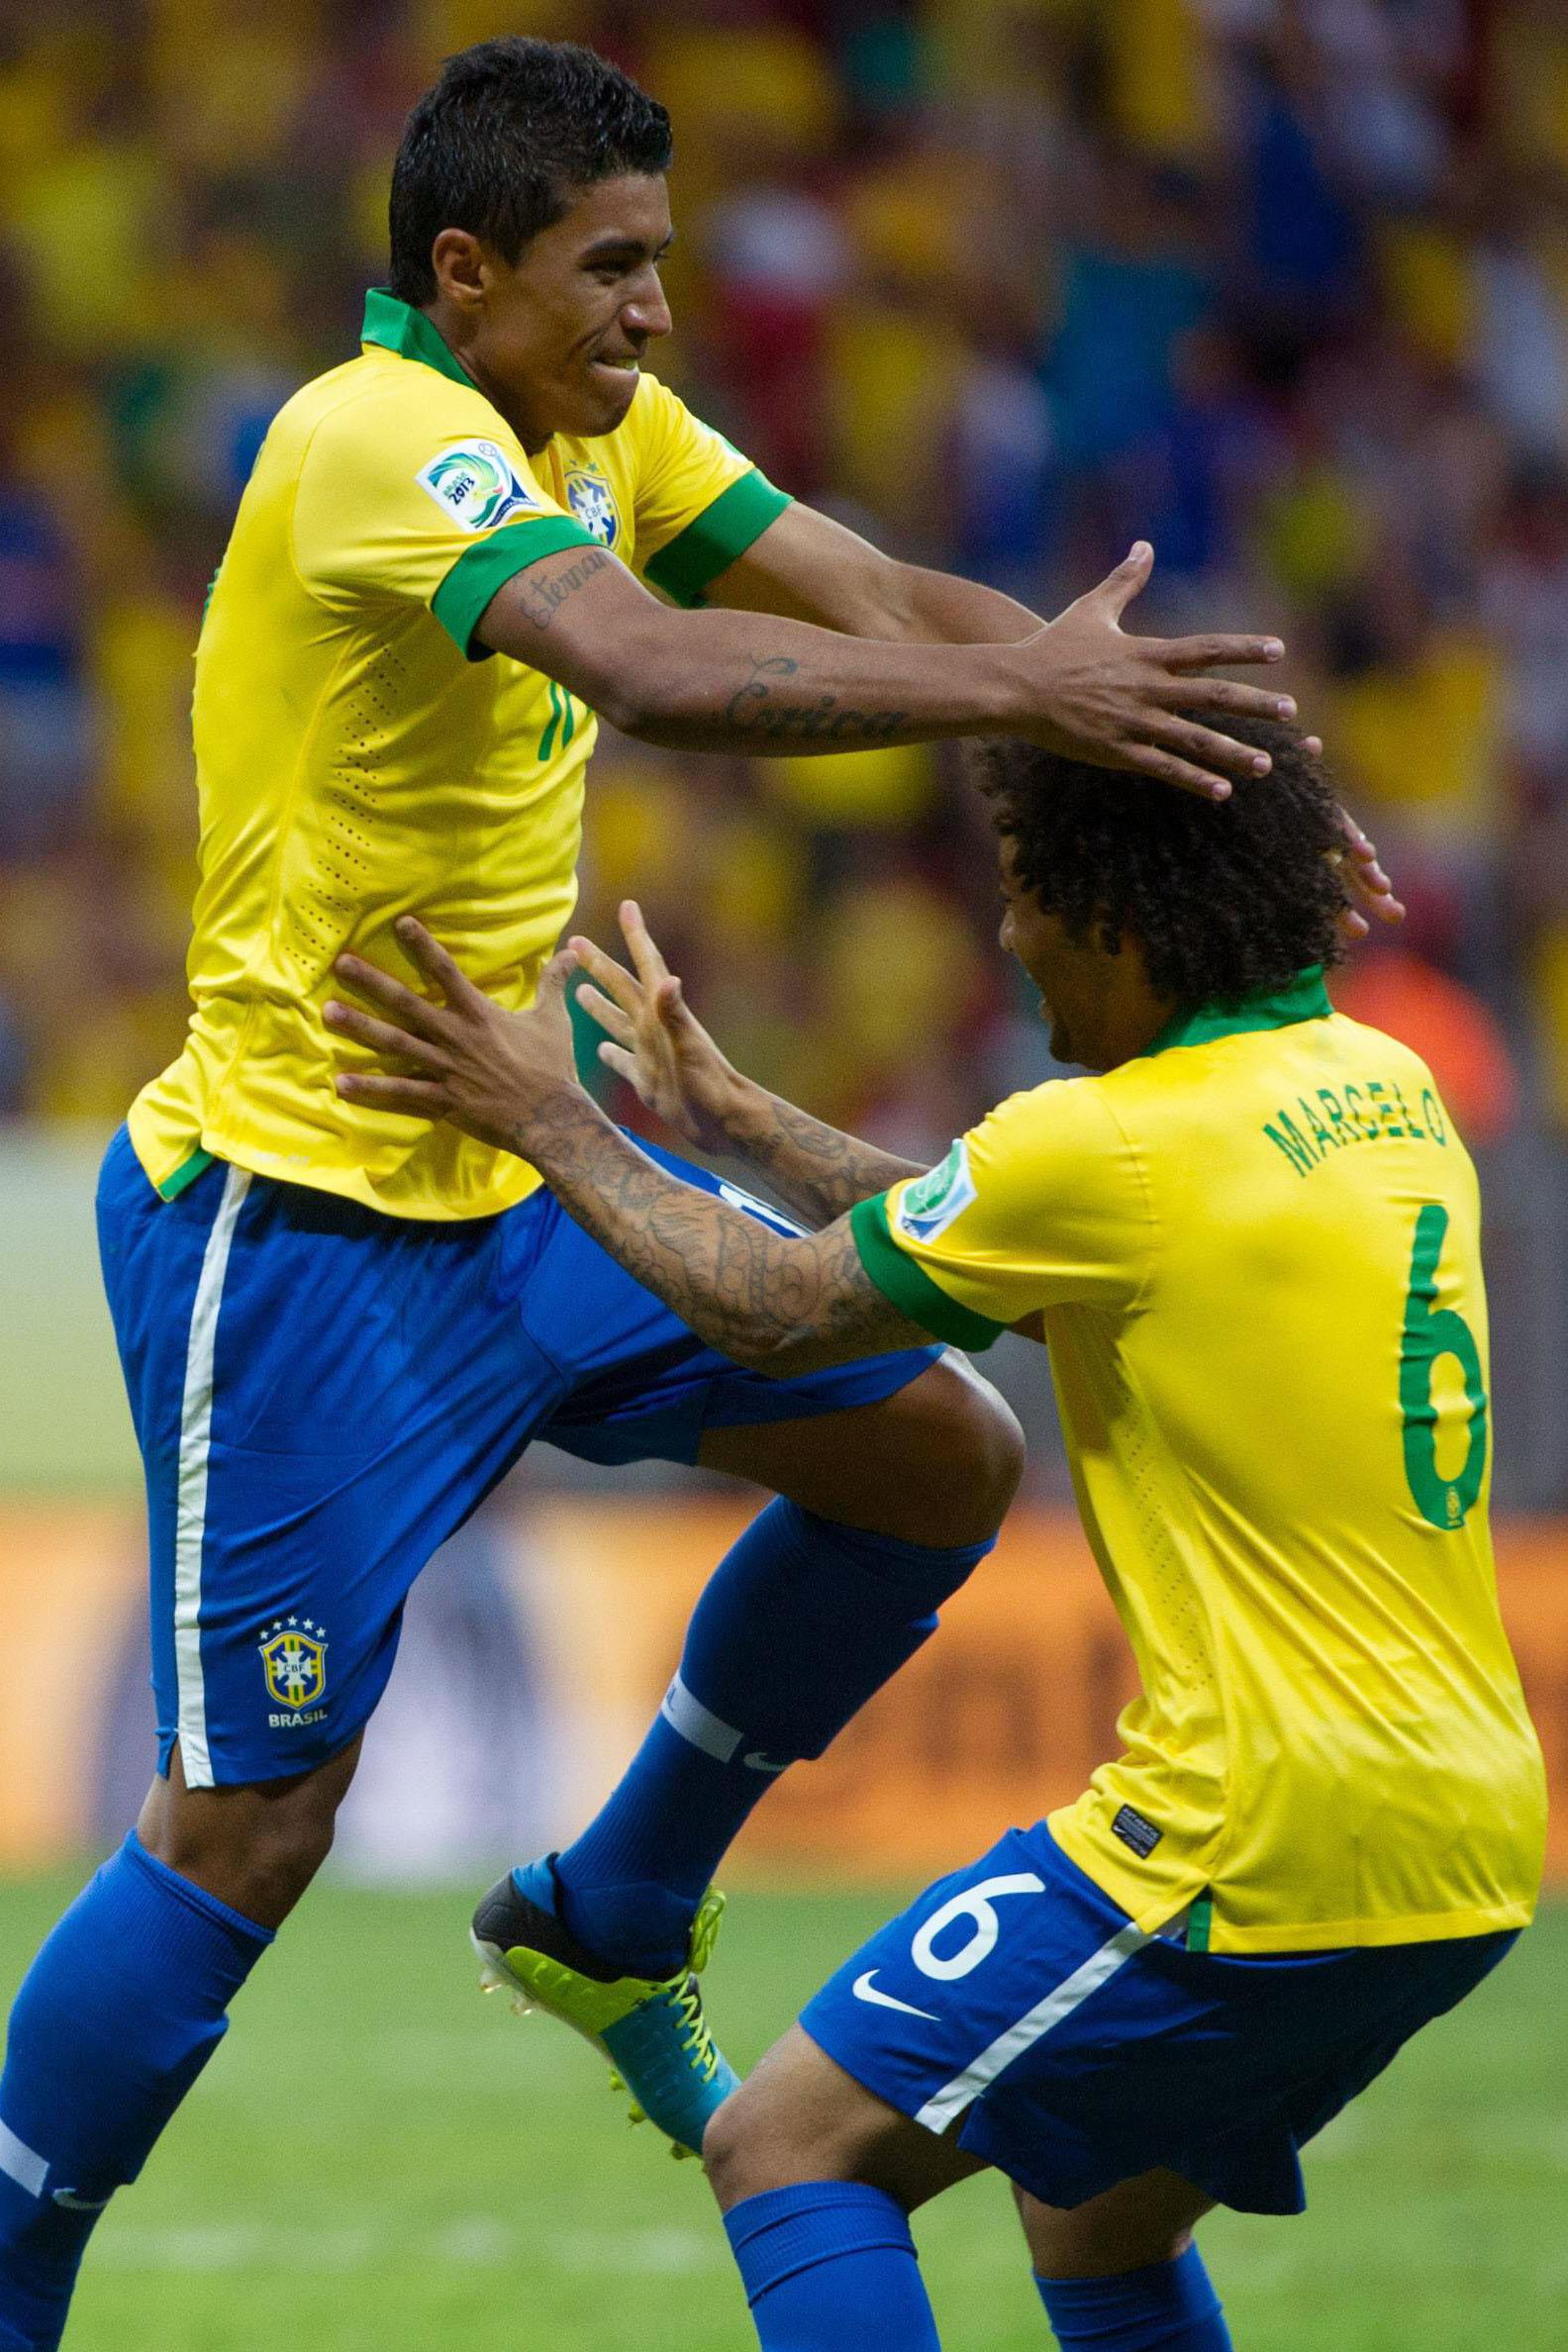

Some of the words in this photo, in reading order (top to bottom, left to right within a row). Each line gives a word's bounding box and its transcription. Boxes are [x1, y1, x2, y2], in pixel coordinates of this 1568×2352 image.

[447, 477, 475, 506] 2013
[1262, 1078, 1446, 1178] MARCELO
[1399, 1204, 1488, 1530] 6
[284, 1662, 304, 1674] CBF
[268, 1710, 328, 1728] BRASIL
[911, 1872, 1045, 1981] 6
